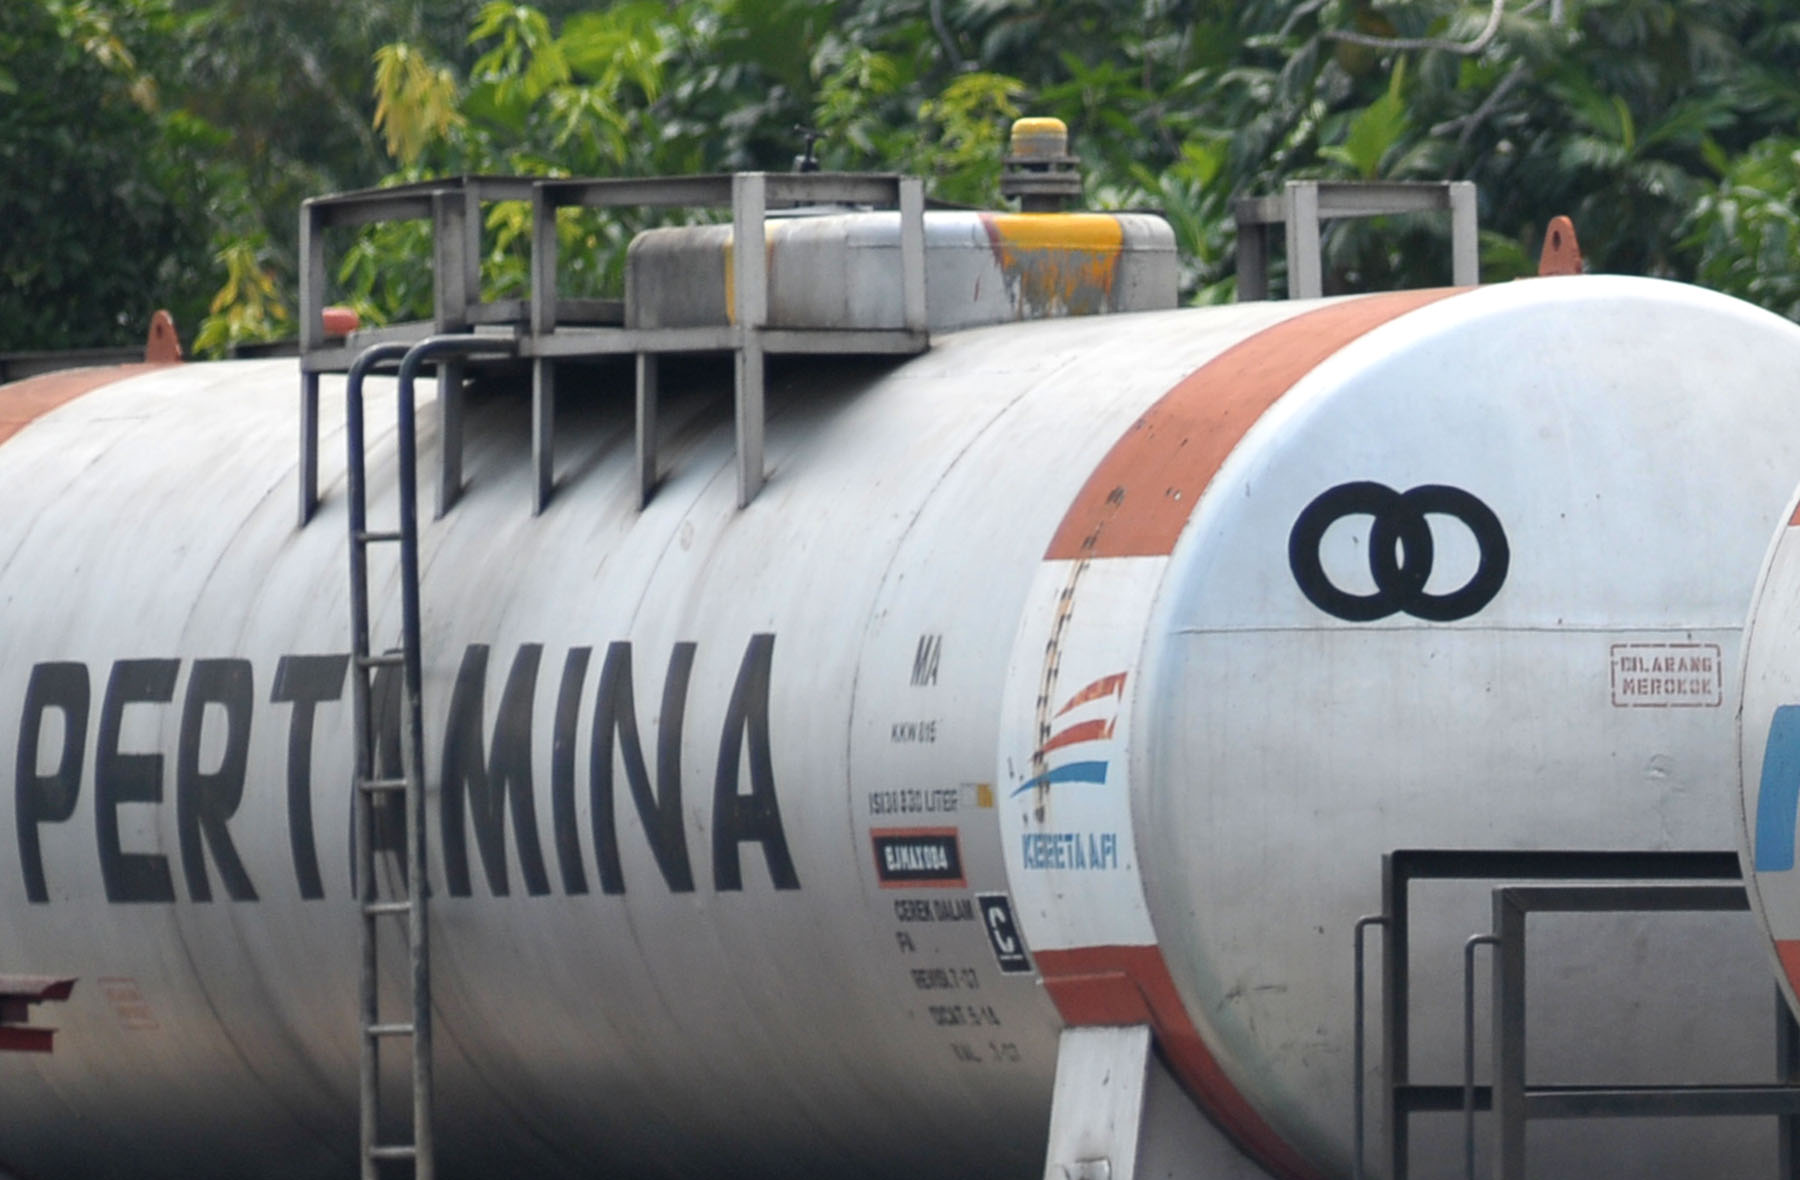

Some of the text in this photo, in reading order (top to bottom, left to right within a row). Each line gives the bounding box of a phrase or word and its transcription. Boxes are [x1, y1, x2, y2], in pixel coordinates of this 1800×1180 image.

[910, 634, 942, 686] MA
[1620, 656, 1712, 673] DILARANG
[1622, 678, 1712, 695] MEROKOK
[1022, 832, 1086, 870] KERETA
[988, 907, 1015, 953] C
